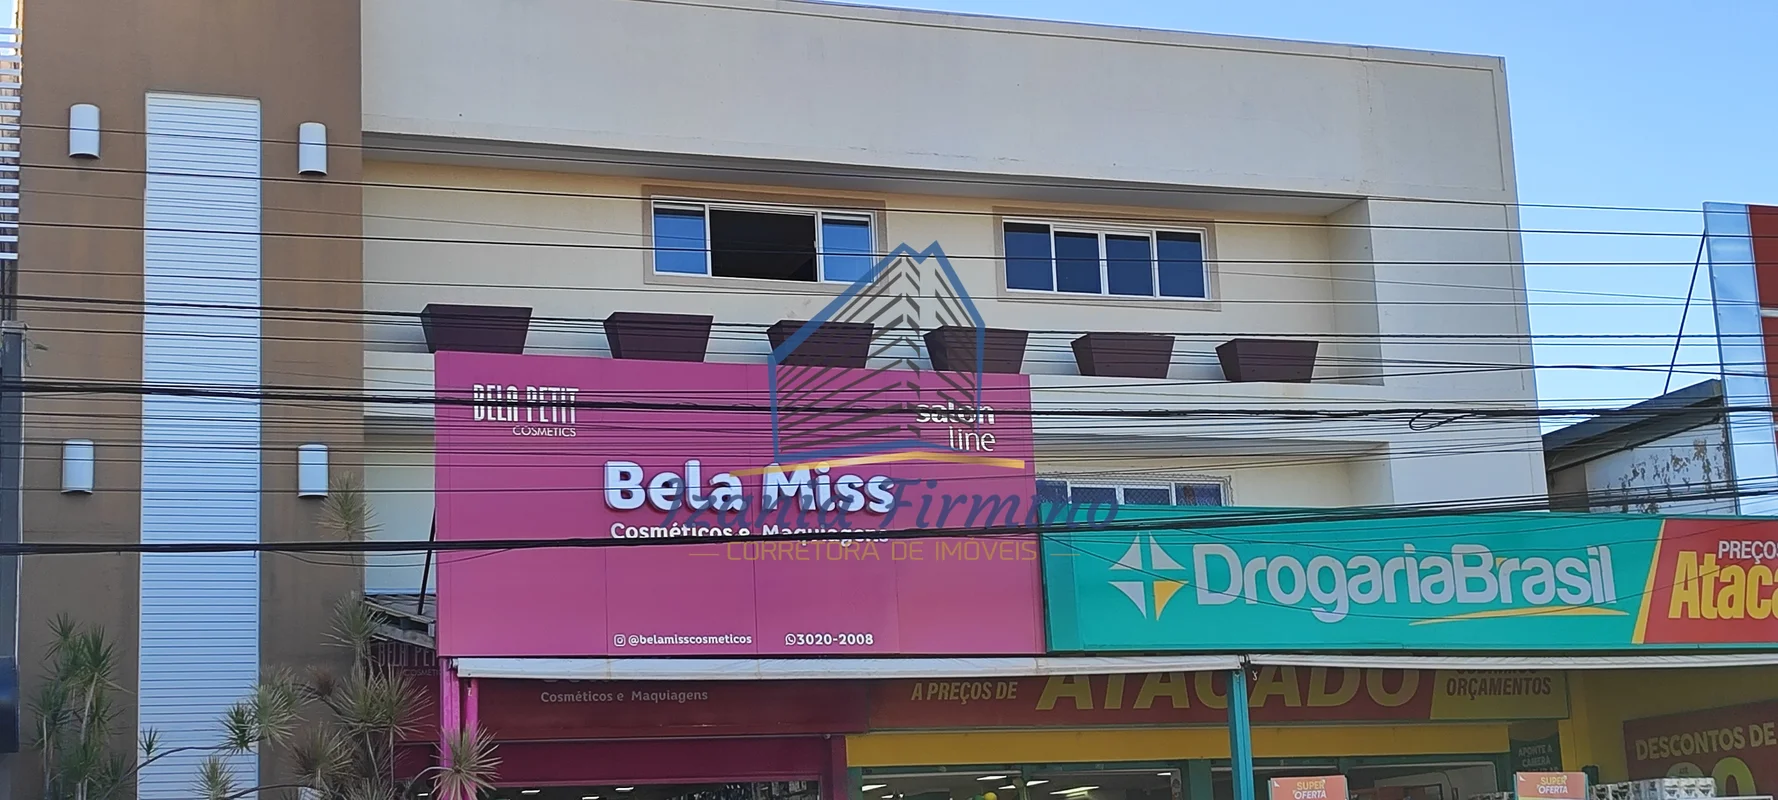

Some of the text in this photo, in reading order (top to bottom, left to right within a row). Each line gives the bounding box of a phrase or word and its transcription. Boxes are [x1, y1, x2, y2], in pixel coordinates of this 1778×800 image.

[473, 384, 579, 424] BELA PETIT
[512, 426, 577, 437] COSMETICS
[949, 425, 996, 451] line
[603, 459, 896, 513] Bela Miss
[610, 522, 733, 540] Cosméticos
[1718, 540, 1778, 564] PREÇO
[1191, 543, 1617, 623] DrogariaBrasil
[1668, 550, 1778, 620] Atac
[628, 634, 753, 646] @belamisscosmeticos
[796, 633, 874, 646] 3020-2008
[540, 689, 709, 703] Cosméticos e Maquiagens
[910, 681, 1018, 705] A PREÇOS DE
[1446, 676, 1552, 700] ORÇAMENTOS
[1635, 721, 1778, 761] DESCONTOS DE
[1297, 780, 1325, 790] SUPER
[1538, 785, 1568, 794] OFERTA
[1540, 775, 1567, 785] SUPER
[1294, 789, 1327, 800] OFERTA
